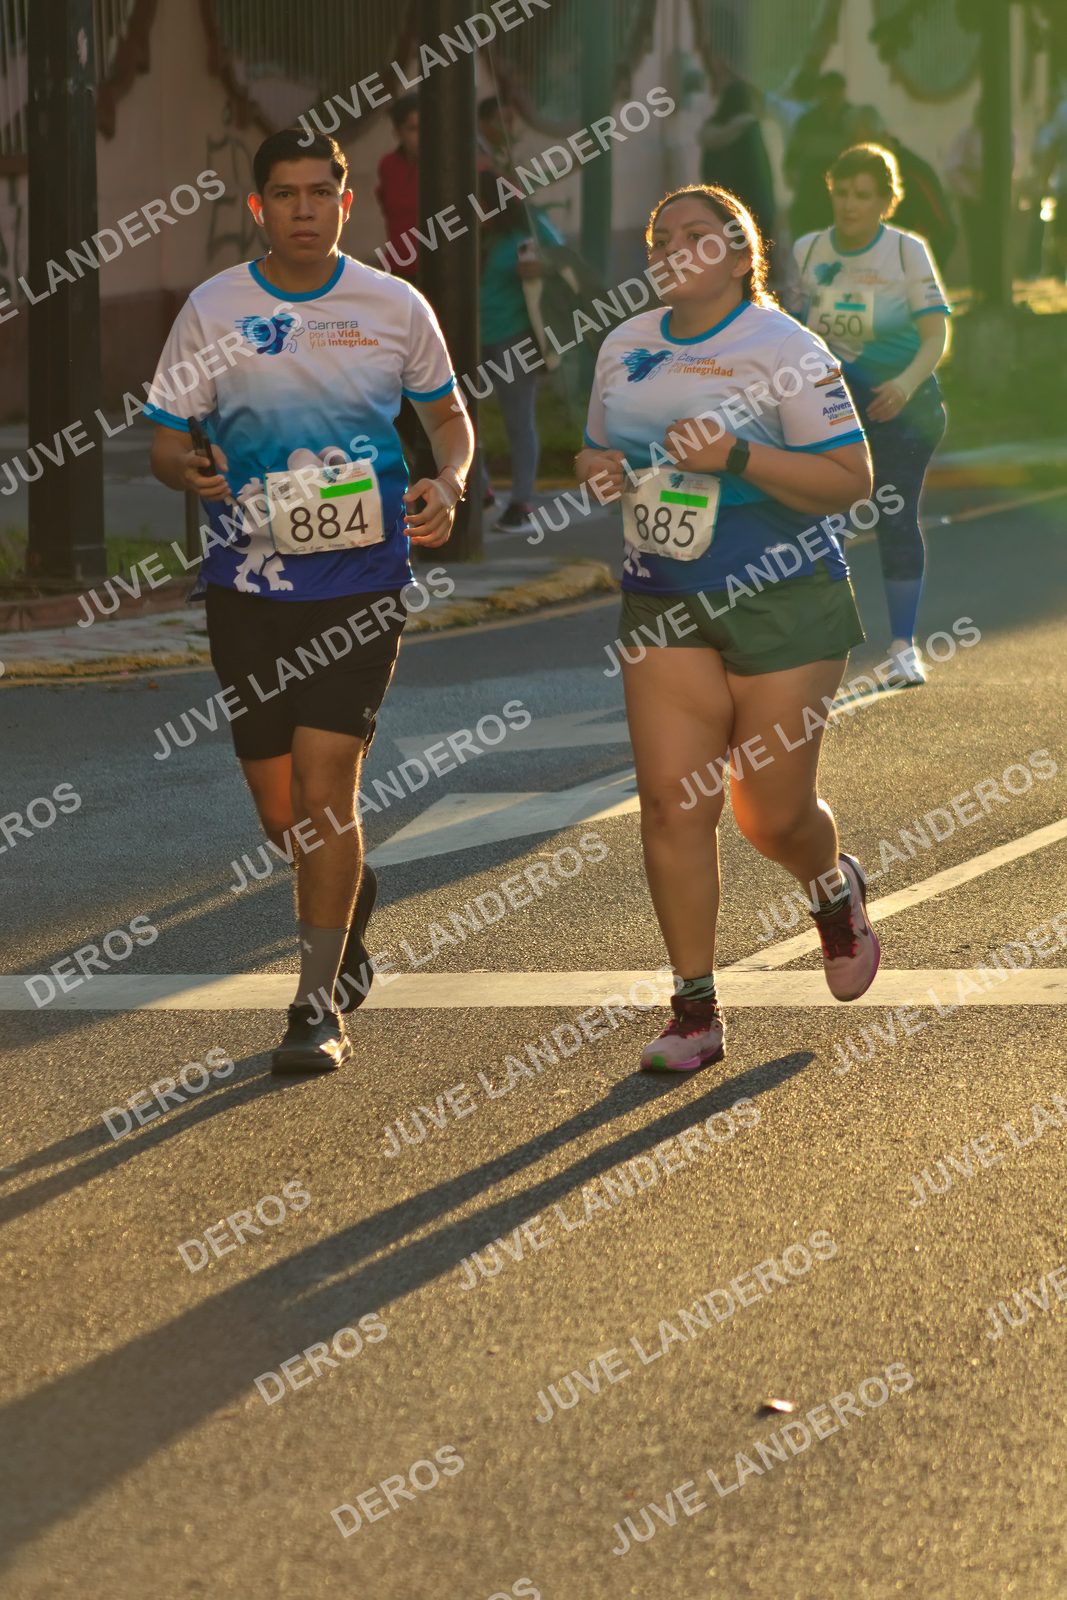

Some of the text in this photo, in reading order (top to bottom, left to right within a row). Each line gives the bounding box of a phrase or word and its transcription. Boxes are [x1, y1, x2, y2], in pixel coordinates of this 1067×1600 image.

[308, 320, 358, 330] Carrera
[337, 329, 360, 337] Vida
[818, 314, 863, 337] 550
[683, 366, 733, 376] Integridad
[290, 498, 368, 542] 884
[634, 504, 697, 548] 885
